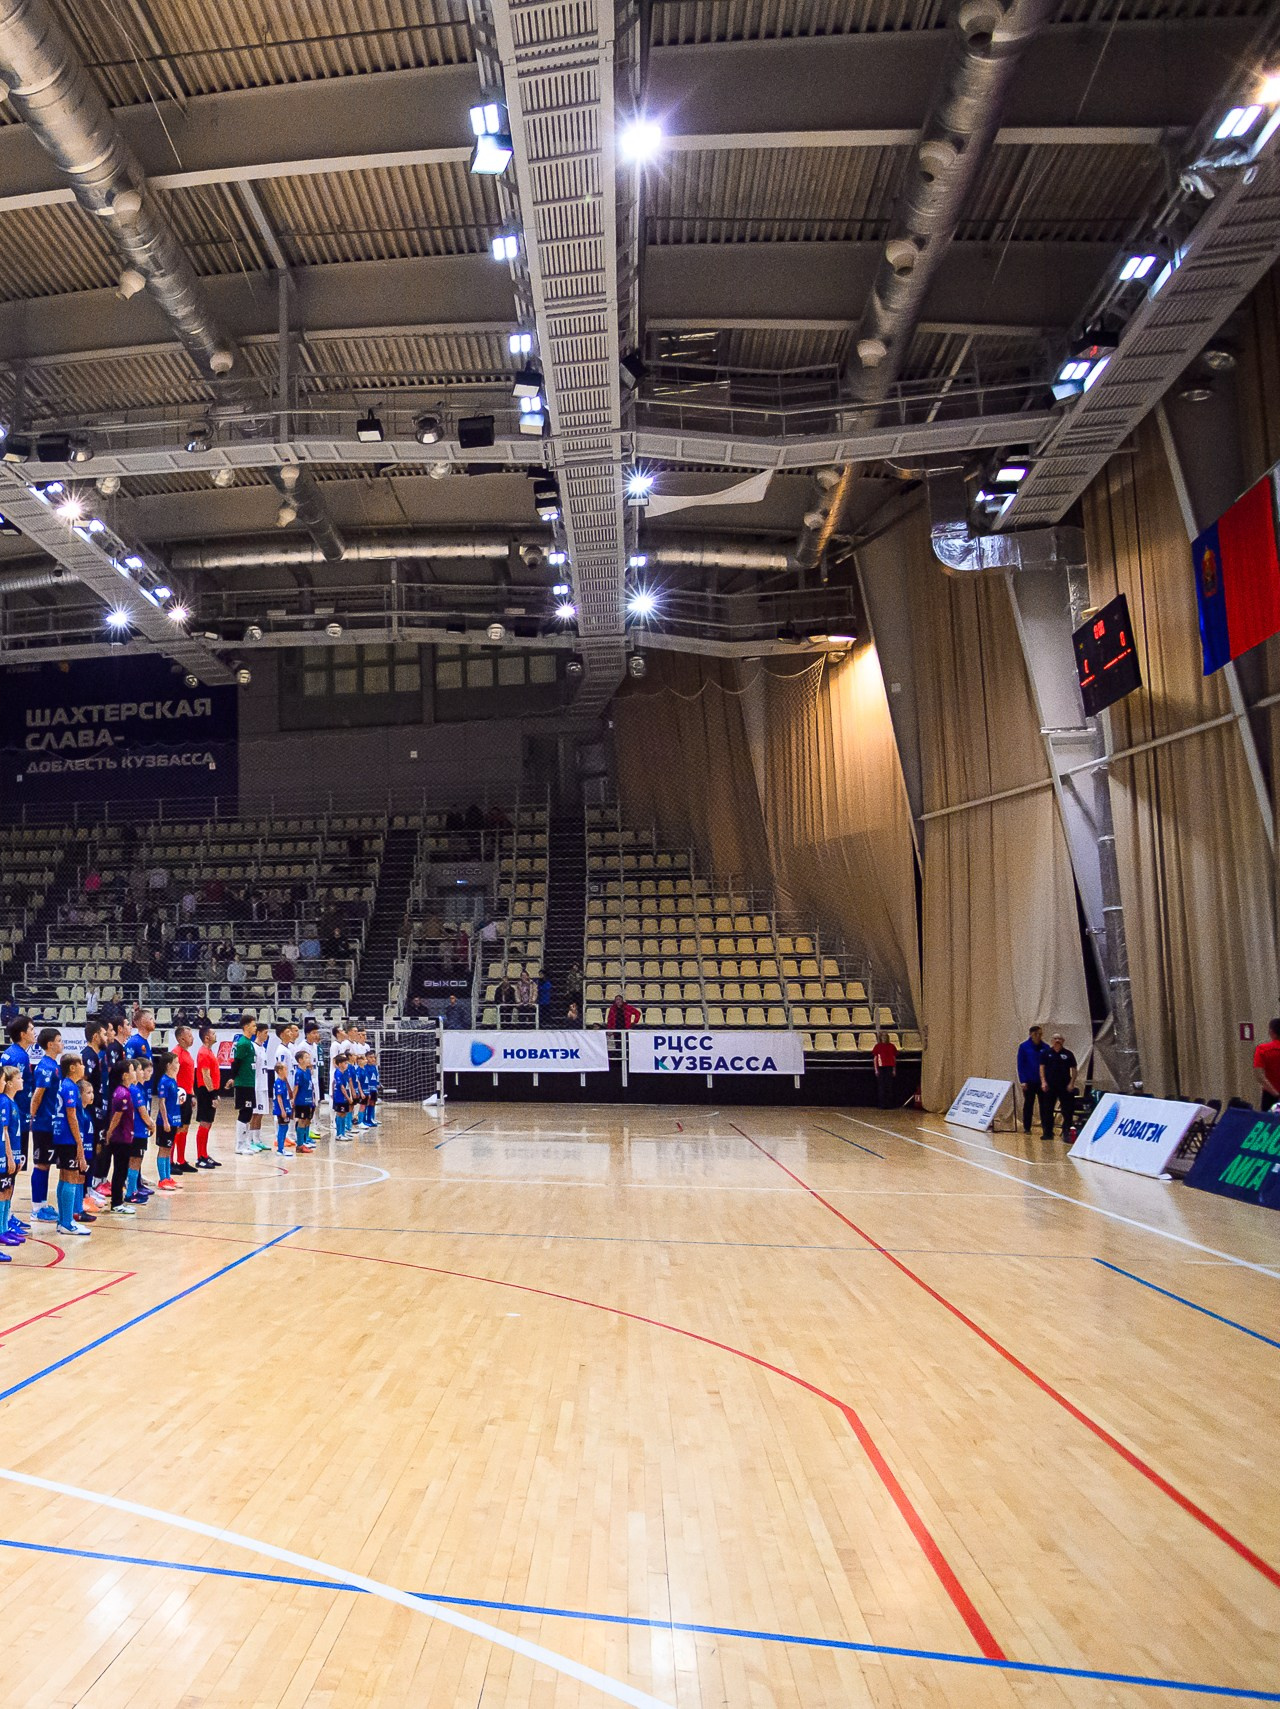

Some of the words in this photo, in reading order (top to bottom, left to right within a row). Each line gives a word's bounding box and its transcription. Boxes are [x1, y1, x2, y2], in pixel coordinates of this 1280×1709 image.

[25, 698, 211, 727] ШАХТЕРСКАЯ
[26, 757, 117, 774] ДОБЛЕСТЬ
[121, 752, 214, 769] КУЗБАССА
[503, 1048, 581, 1060] НОВАТЭК
[653, 1035, 714, 1053] РЦСС
[653, 1056, 778, 1072] КУЗБАССА
[1114, 1117, 1168, 1144] НОВАТЭК
[1241, 1121, 1280, 1156] ВЫС
[1218, 1154, 1272, 1191] ЛИГА
